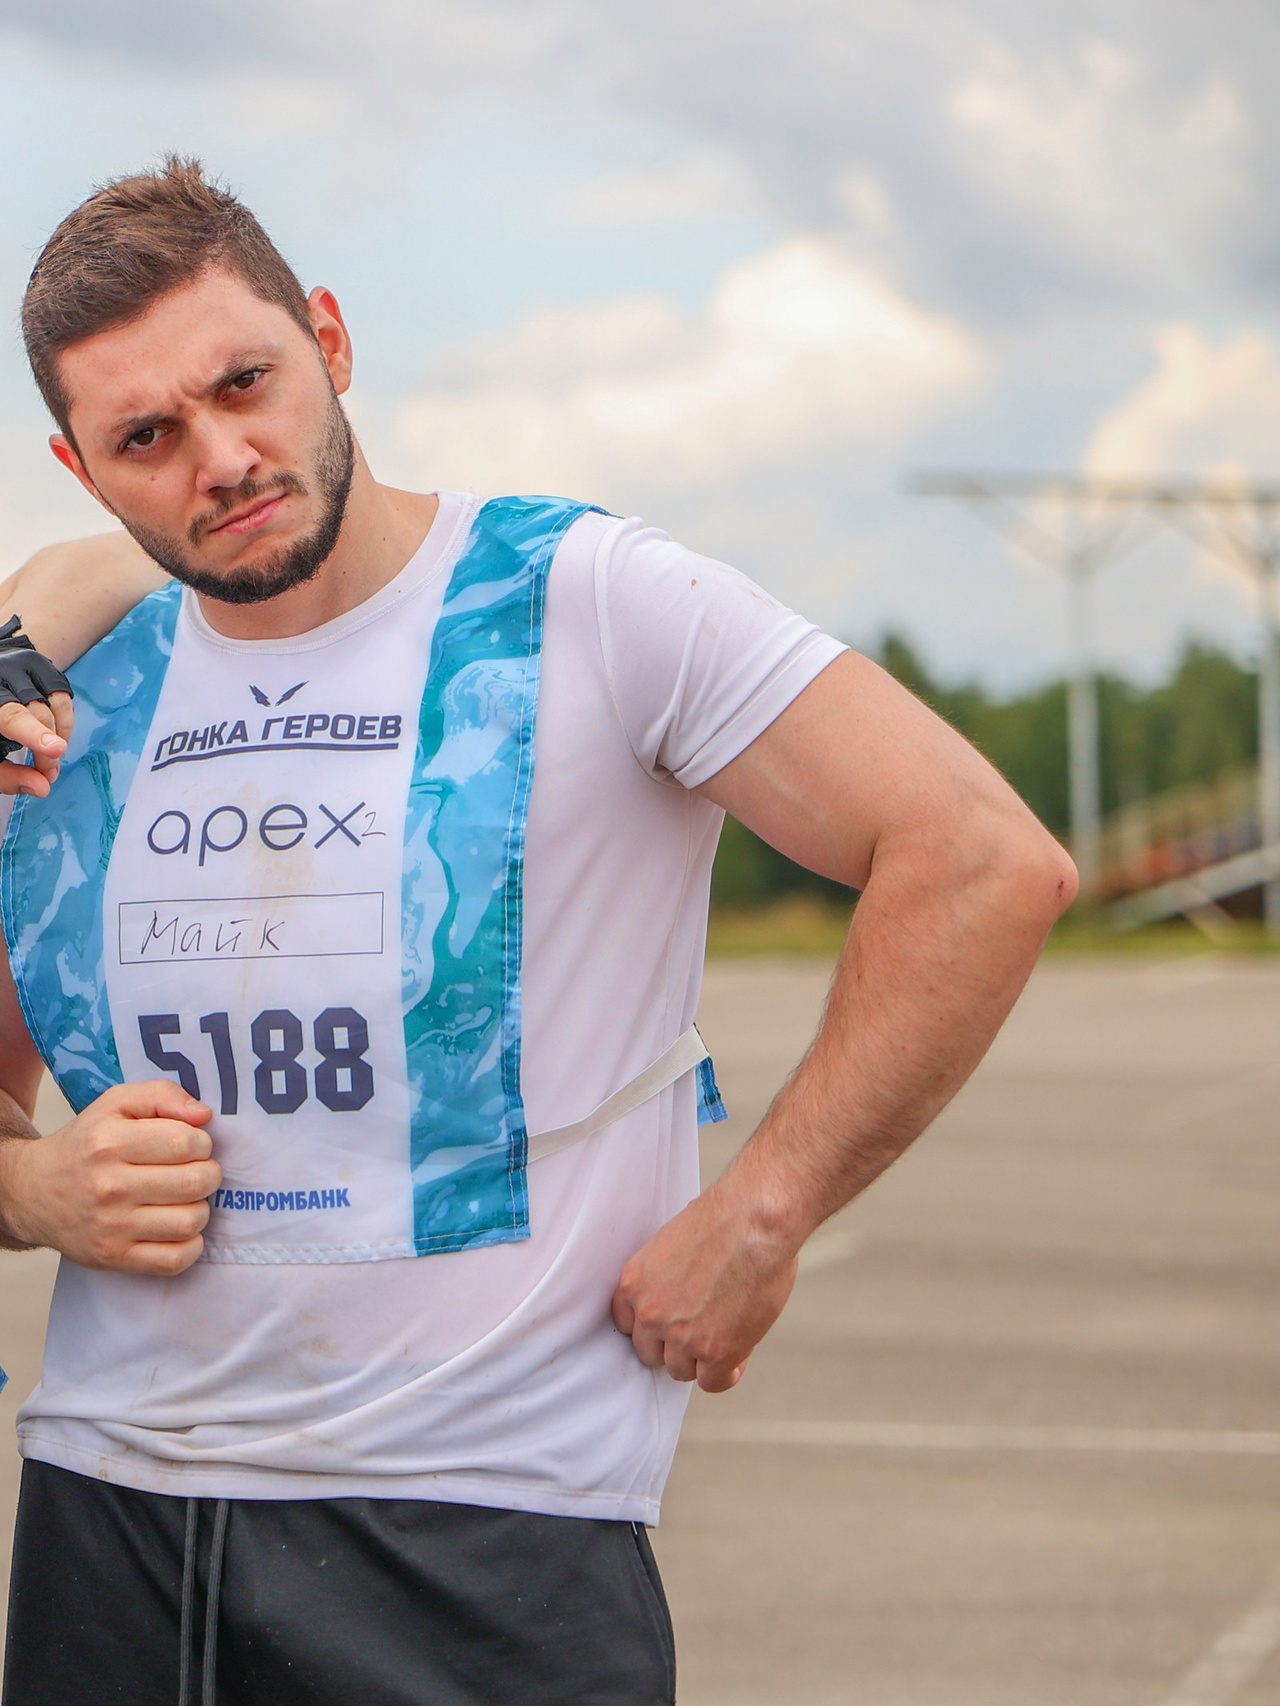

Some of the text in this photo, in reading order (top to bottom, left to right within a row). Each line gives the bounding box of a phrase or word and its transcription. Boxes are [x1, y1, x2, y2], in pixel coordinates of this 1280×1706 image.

[153, 713, 403, 762] ГОНКА ГЕРОЕВ
[147, 800, 366, 867] apex
[140, 910, 286, 956] Майк
[137, 1006, 375, 1116] 5188
[214, 1187, 351, 1212] ГАЗПРОМБАНК
